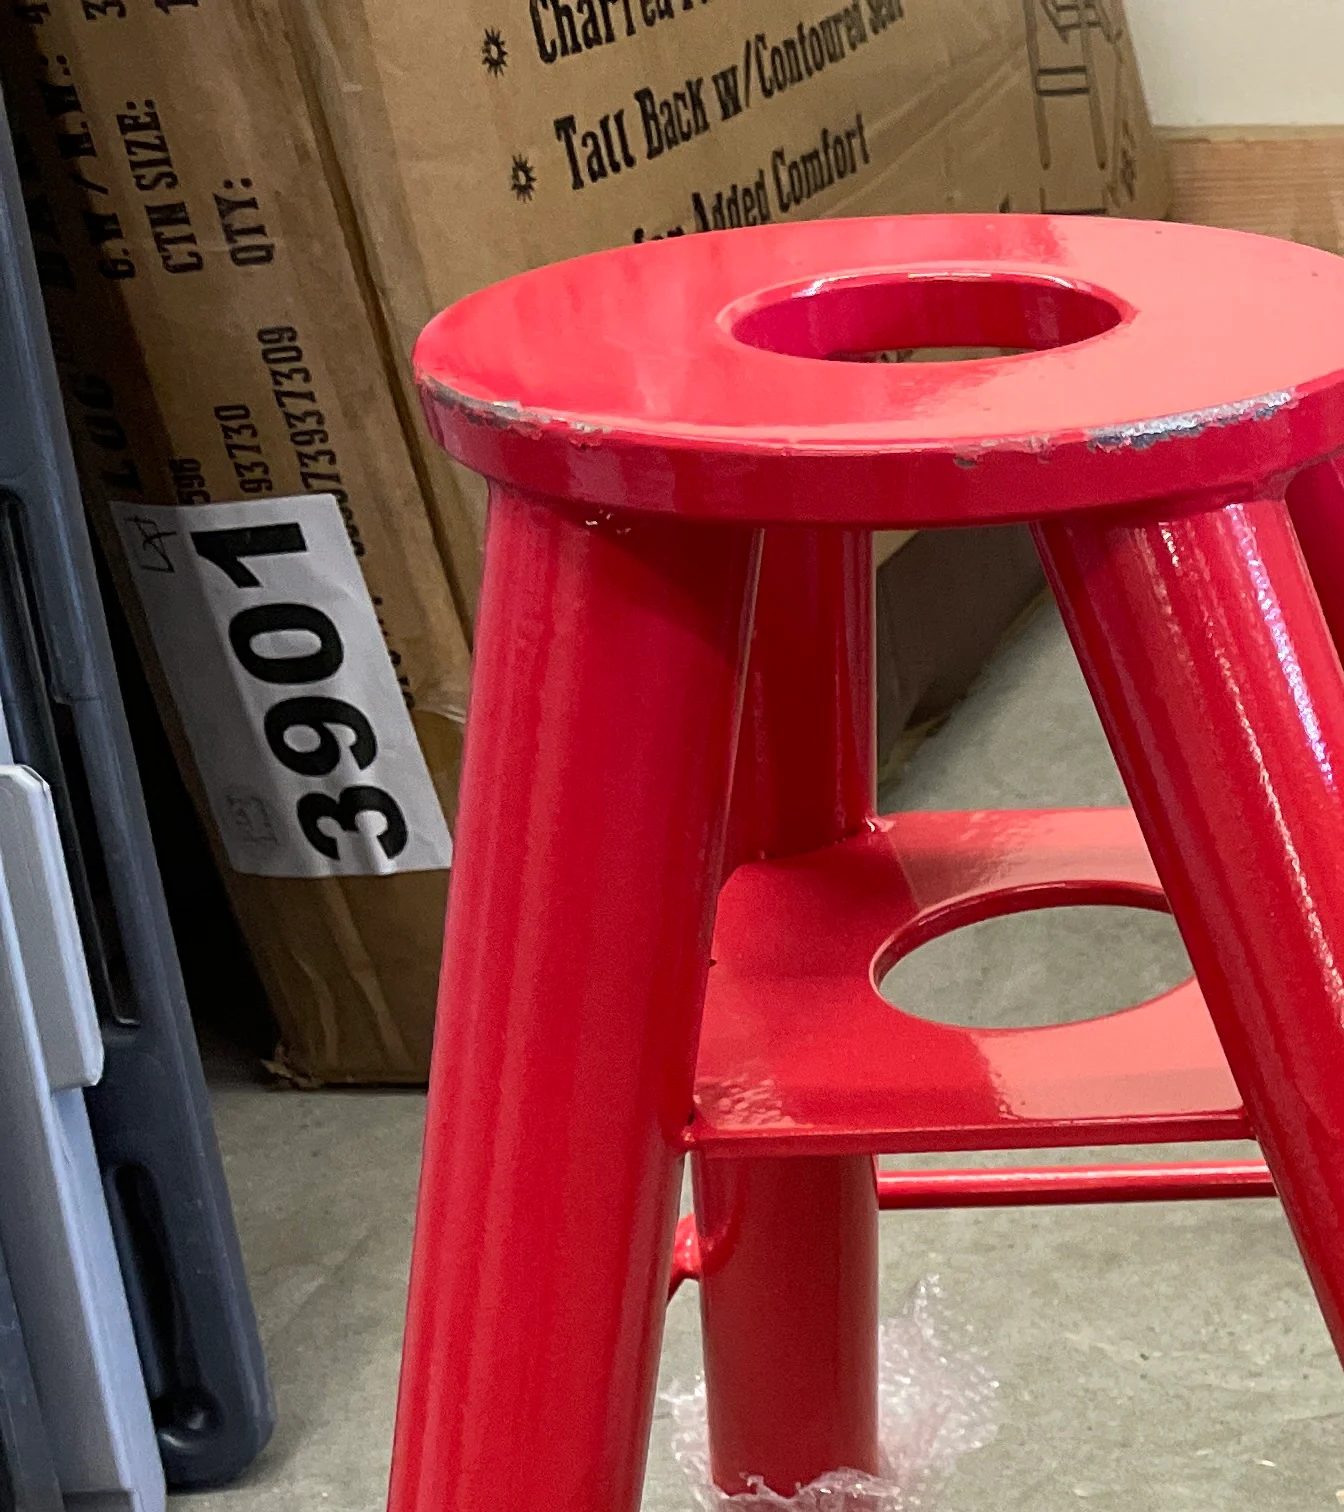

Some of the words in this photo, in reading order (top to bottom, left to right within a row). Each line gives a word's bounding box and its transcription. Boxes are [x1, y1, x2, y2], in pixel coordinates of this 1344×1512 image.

[116, 99, 179, 191] SIZE:
[554, 109, 637, 190] Tall
[634, 78, 710, 160] Back
[691, 168, 771, 234] Added
[770, 112, 872, 214] Comfort
[212, 177, 275, 267] QTY:
[214, 404, 273, 494] 93730
[190, 522, 408, 861] 3901
